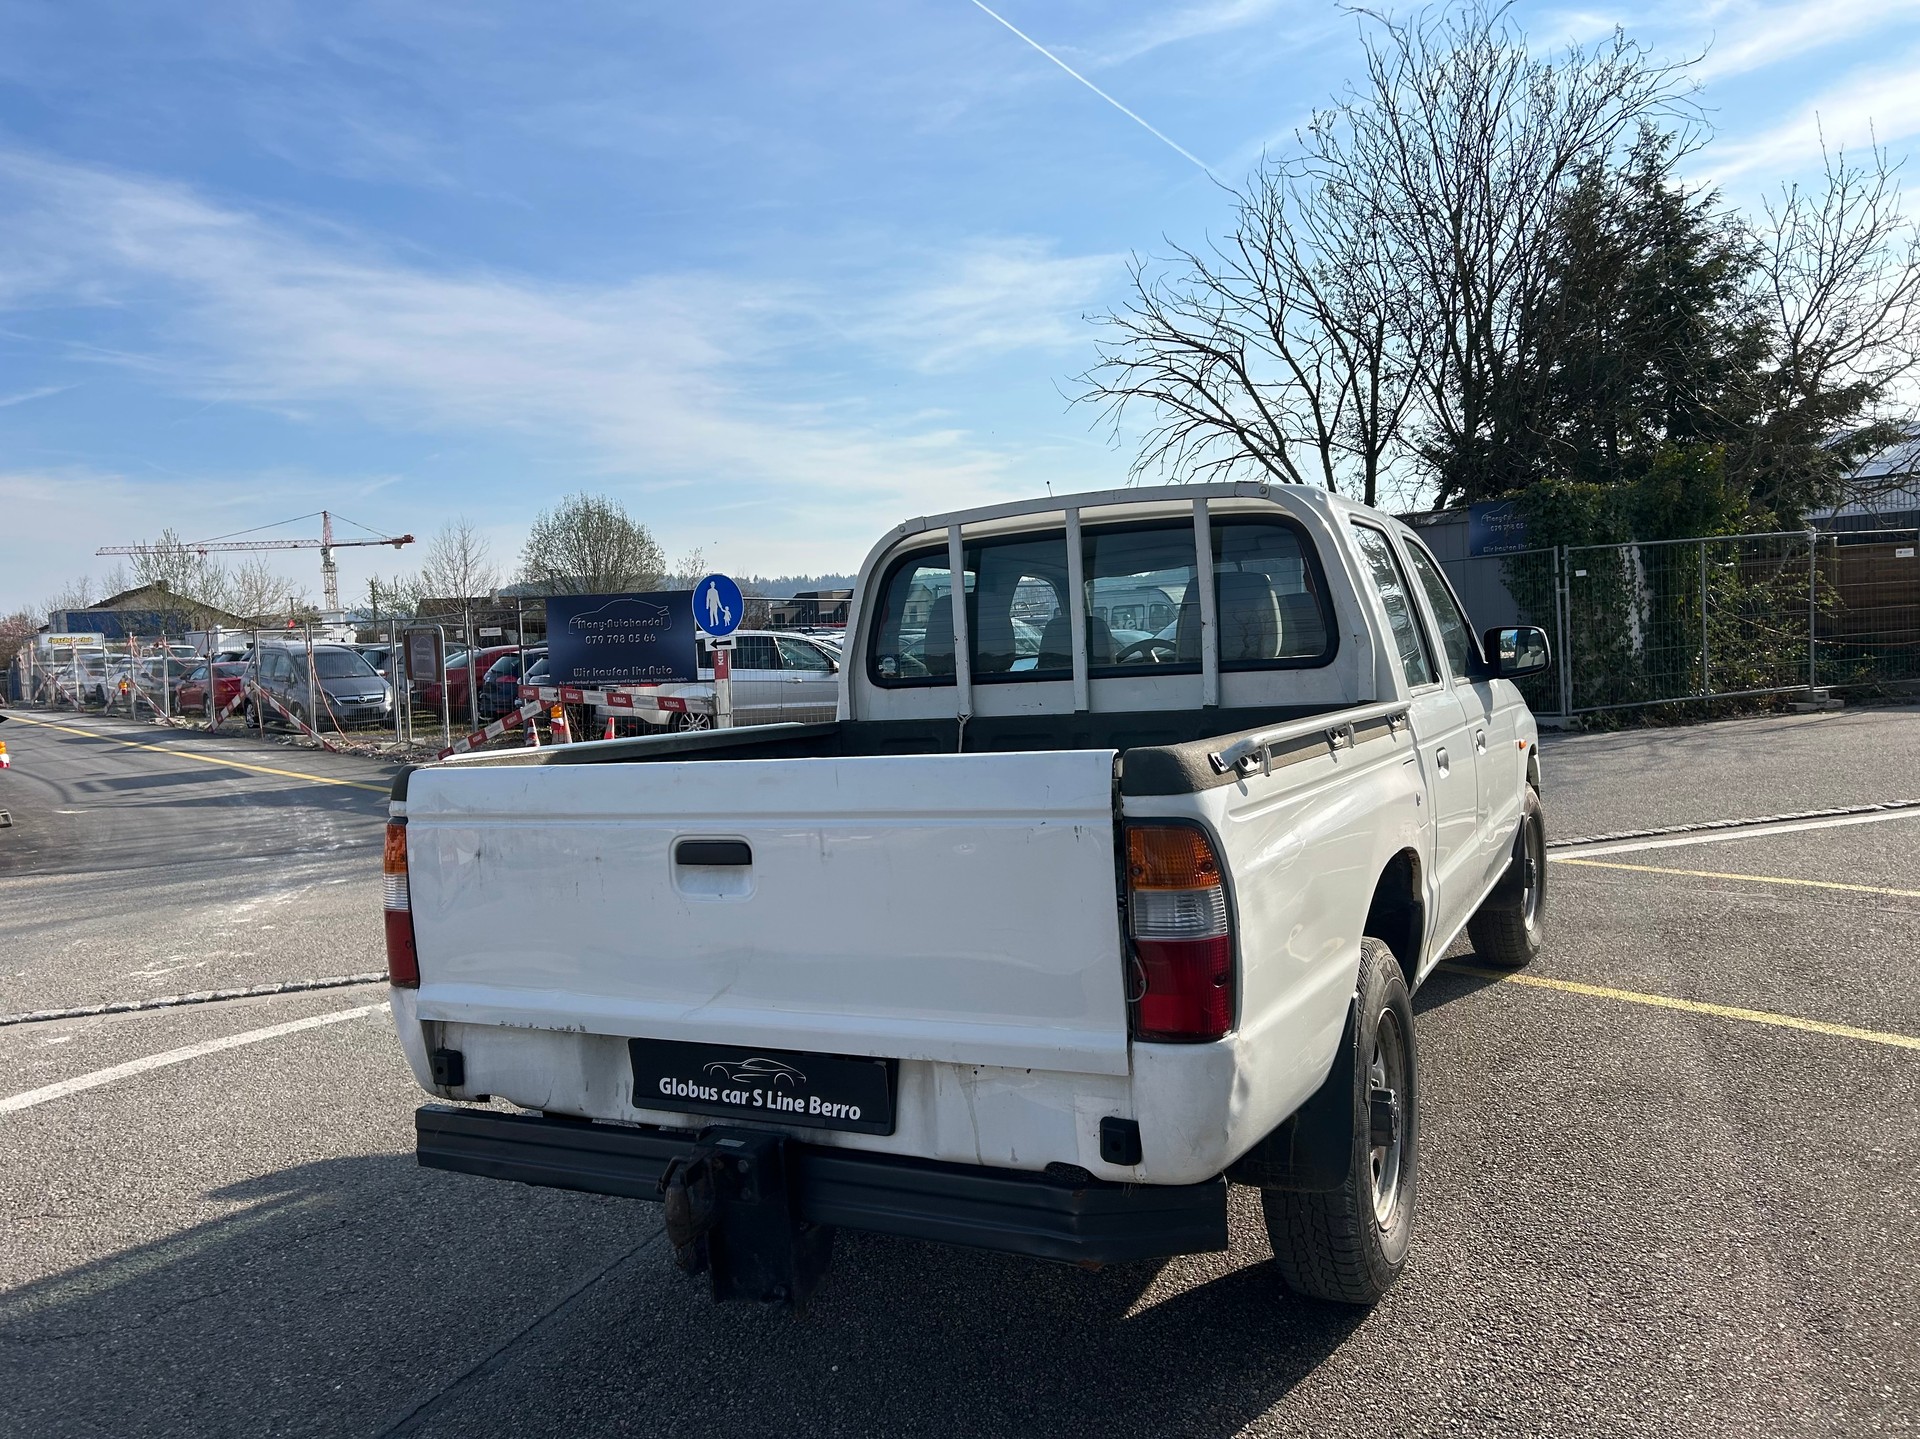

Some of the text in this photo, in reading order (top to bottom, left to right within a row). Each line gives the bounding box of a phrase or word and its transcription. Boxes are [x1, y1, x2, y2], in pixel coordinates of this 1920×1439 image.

[585, 633, 657, 645] 079 798 05 66
[573, 665, 673, 677] Wir kaufen Ihr Auto
[658, 1077, 861, 1120] Globus car S Line Berro
